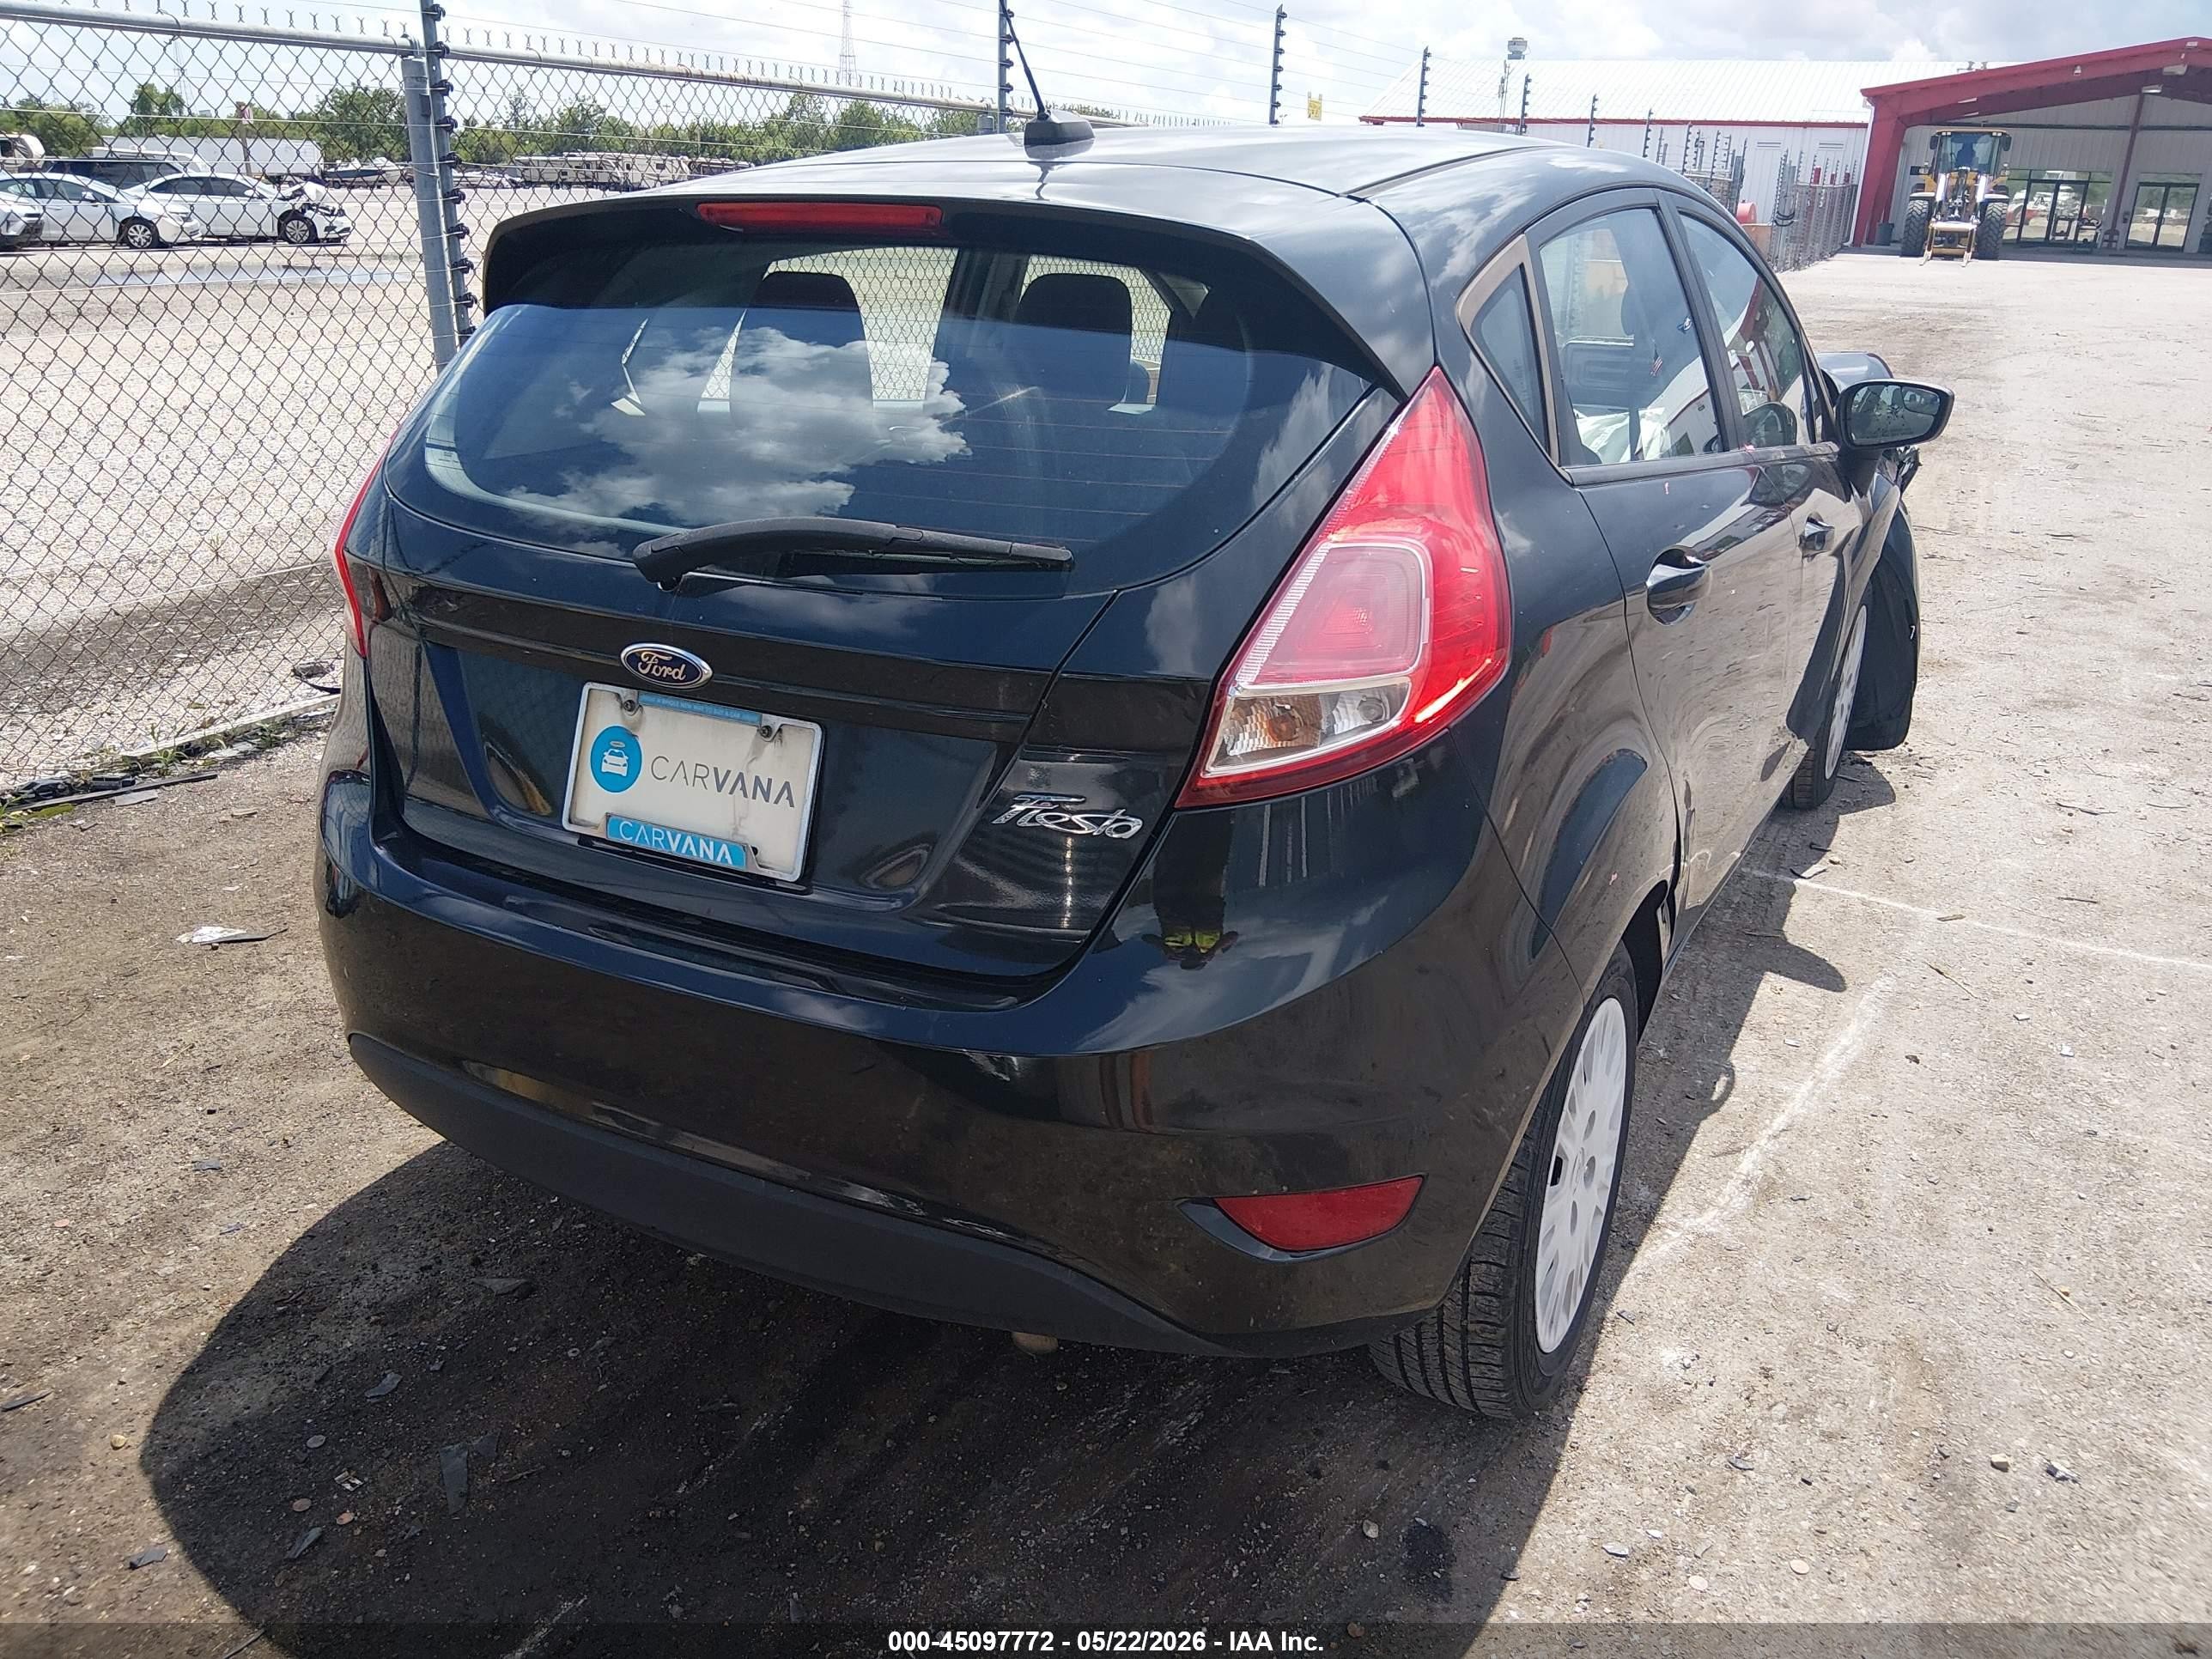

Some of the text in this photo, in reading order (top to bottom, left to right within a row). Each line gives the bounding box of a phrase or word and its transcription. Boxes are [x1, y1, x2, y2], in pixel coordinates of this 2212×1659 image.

[637, 651, 687, 681] Ford
[651, 756, 794, 808] CARVANA
[991, 794, 1144, 839] Fiesta
[619, 820, 733, 866] CARVANA
